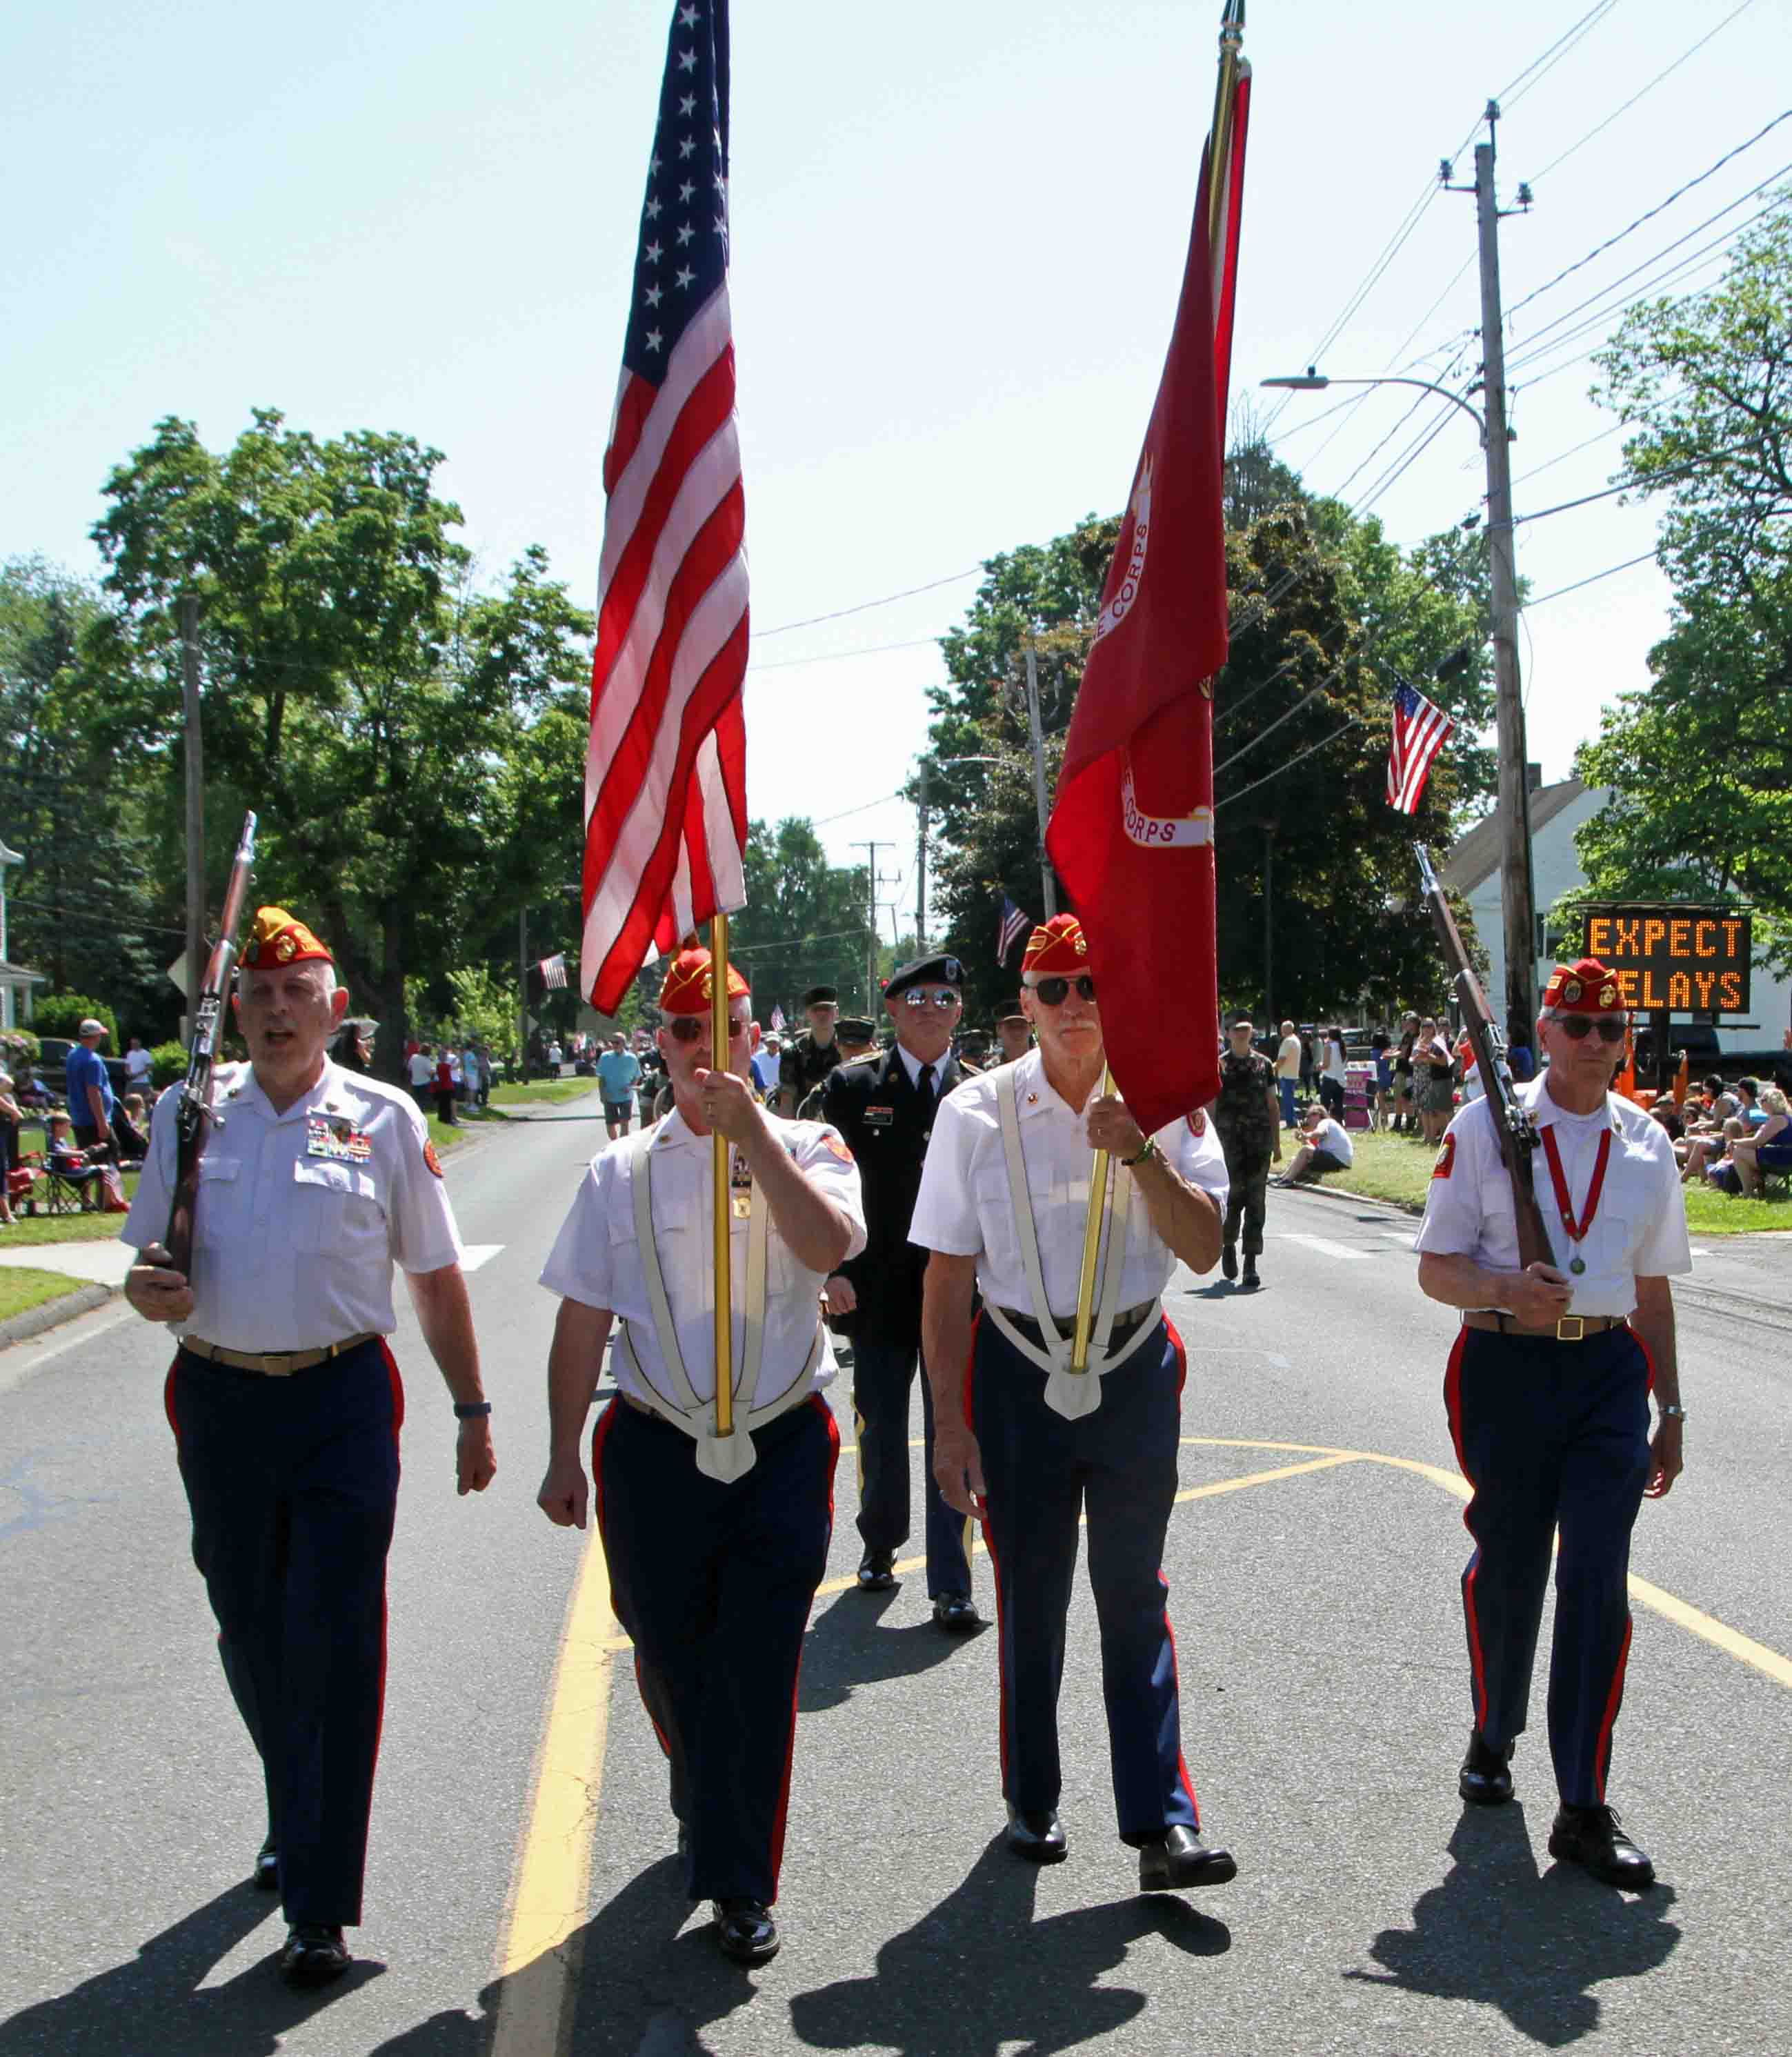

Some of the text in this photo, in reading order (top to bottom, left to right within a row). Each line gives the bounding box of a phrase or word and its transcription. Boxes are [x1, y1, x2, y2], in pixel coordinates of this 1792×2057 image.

[1112, 524, 1147, 617] CORPS
[1126, 797, 1176, 842] CORPS
[1589, 918, 1742, 957] EXPECT
[1618, 971, 1742, 1008] ELAYS
